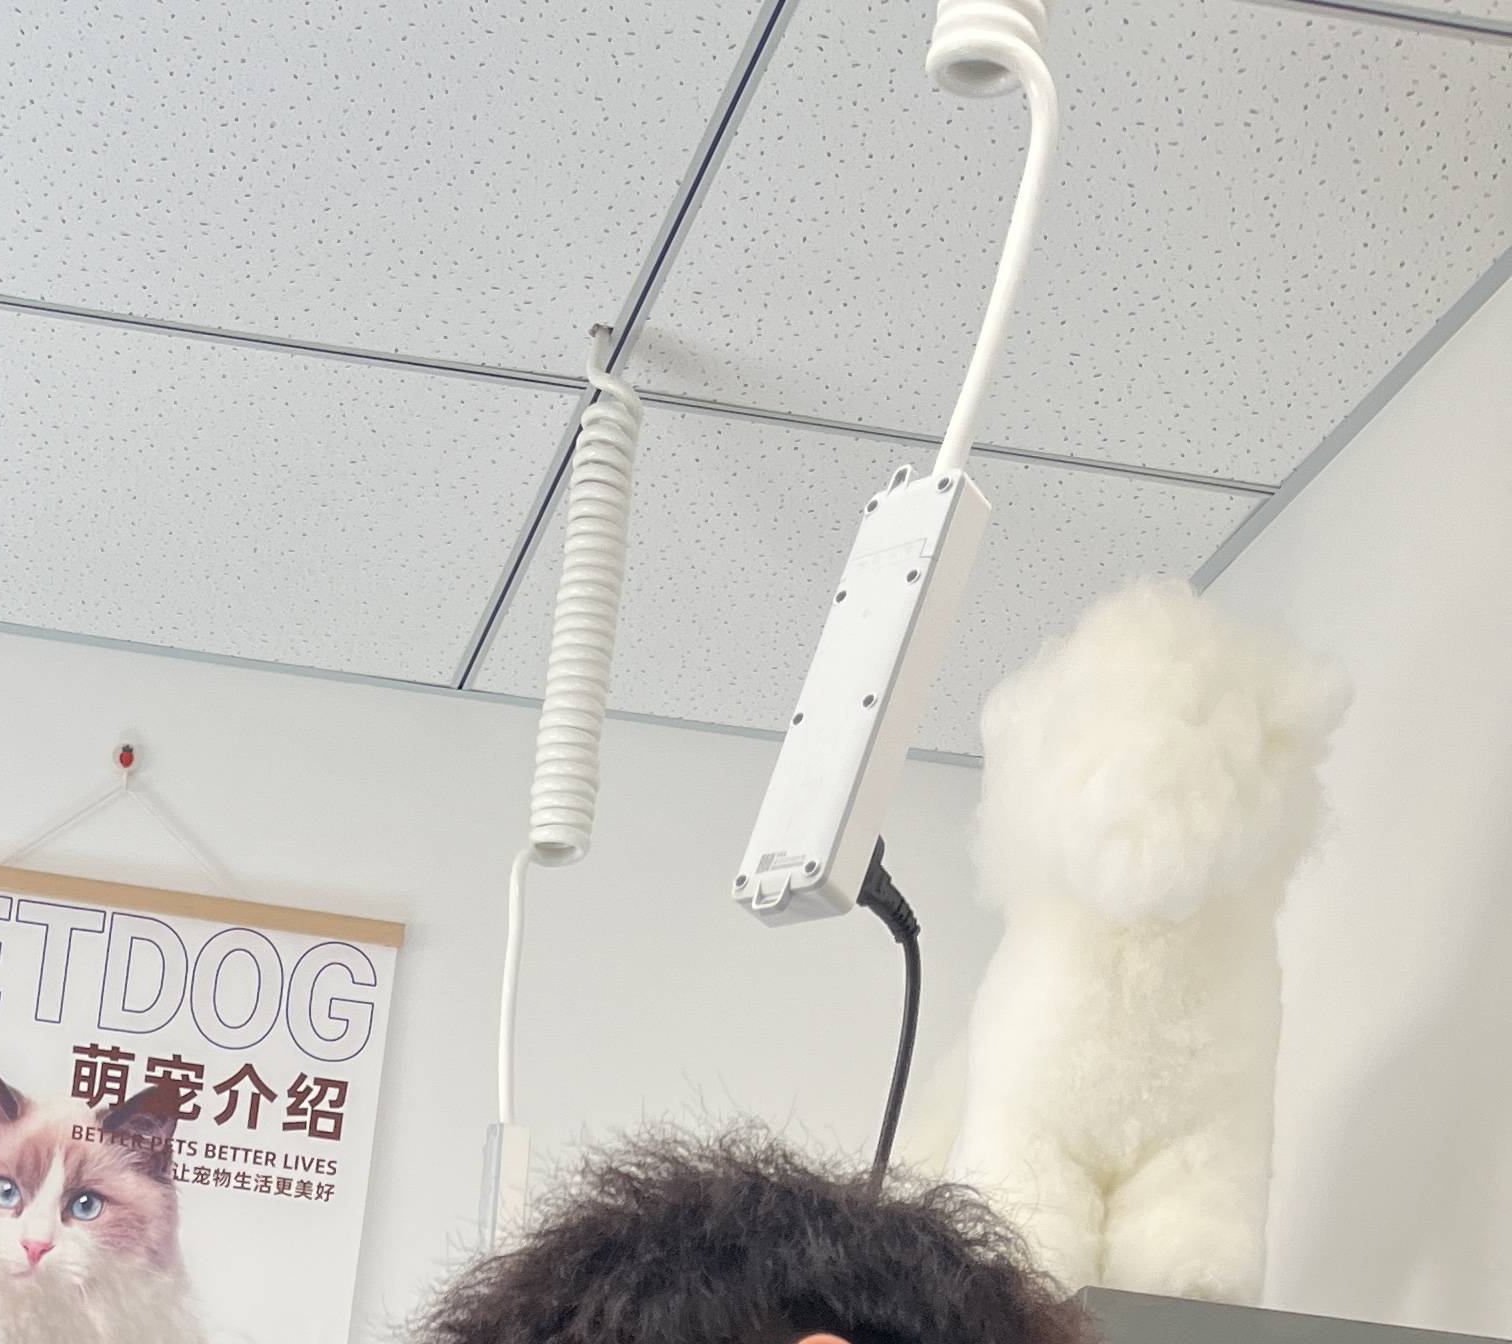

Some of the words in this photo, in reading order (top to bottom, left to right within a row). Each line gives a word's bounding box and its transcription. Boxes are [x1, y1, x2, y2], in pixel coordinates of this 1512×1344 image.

[71, 1043, 349, 1141] 萌宠介绍
[204, 1143, 277, 1168] BETTER
[283, 1153, 338, 1176] LIVES
[173, 1162, 335, 1202] 让宠物生活更美好
